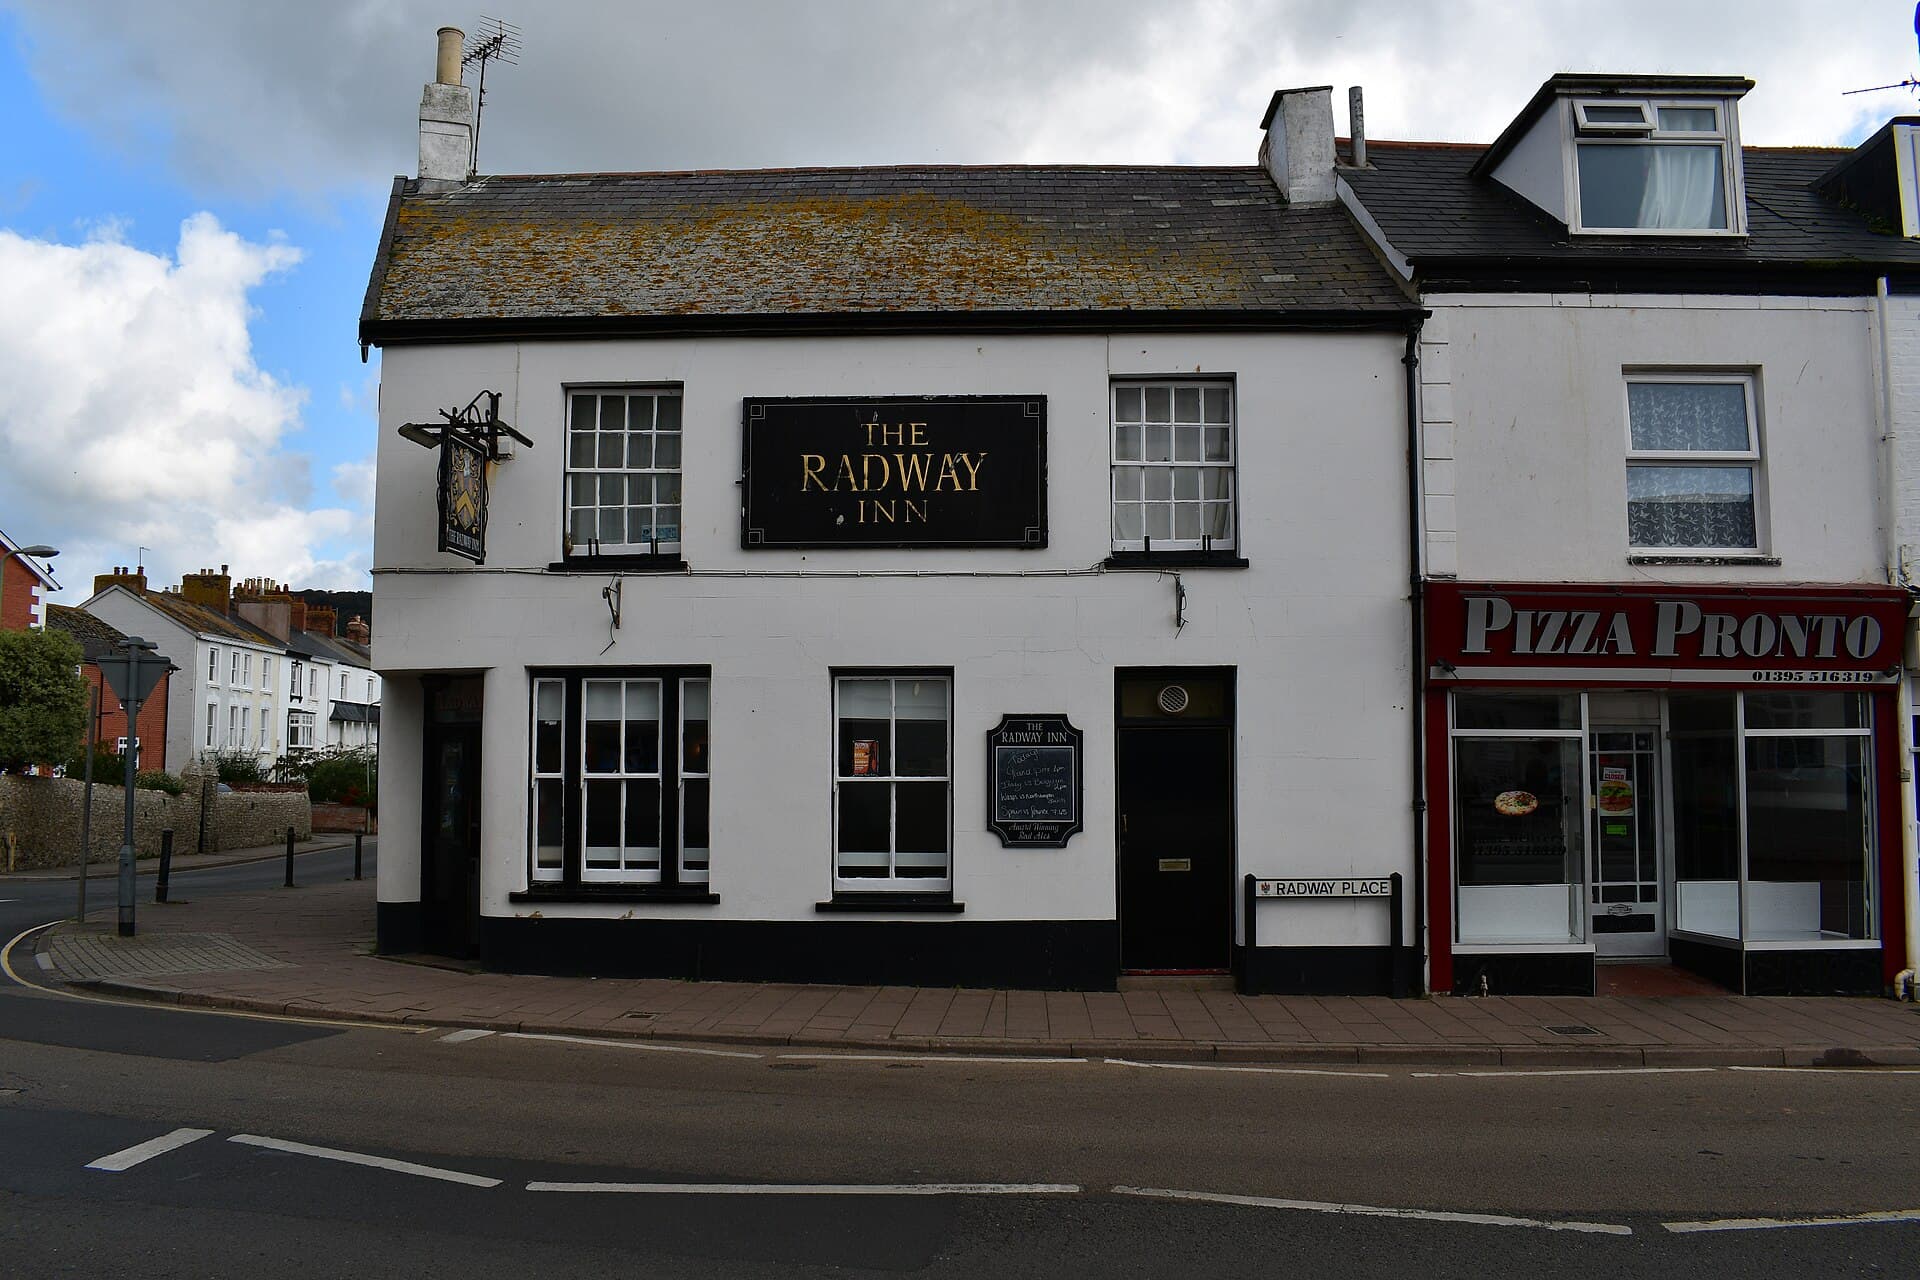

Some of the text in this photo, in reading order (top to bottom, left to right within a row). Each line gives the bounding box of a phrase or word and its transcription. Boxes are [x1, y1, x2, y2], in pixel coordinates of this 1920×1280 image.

[861, 423, 929, 446] THE
[800, 452, 988, 491] RADWAY
[858, 500, 928, 523] INN
[1461, 597, 1881, 659] PIZZA PRONTO
[1752, 671, 1873, 682] 01395 516319
[1025, 722, 1043, 731] THE
[1002, 732, 1067, 743] RADWAY INN
[1276, 881, 1389, 895] RADWAY PLACE
